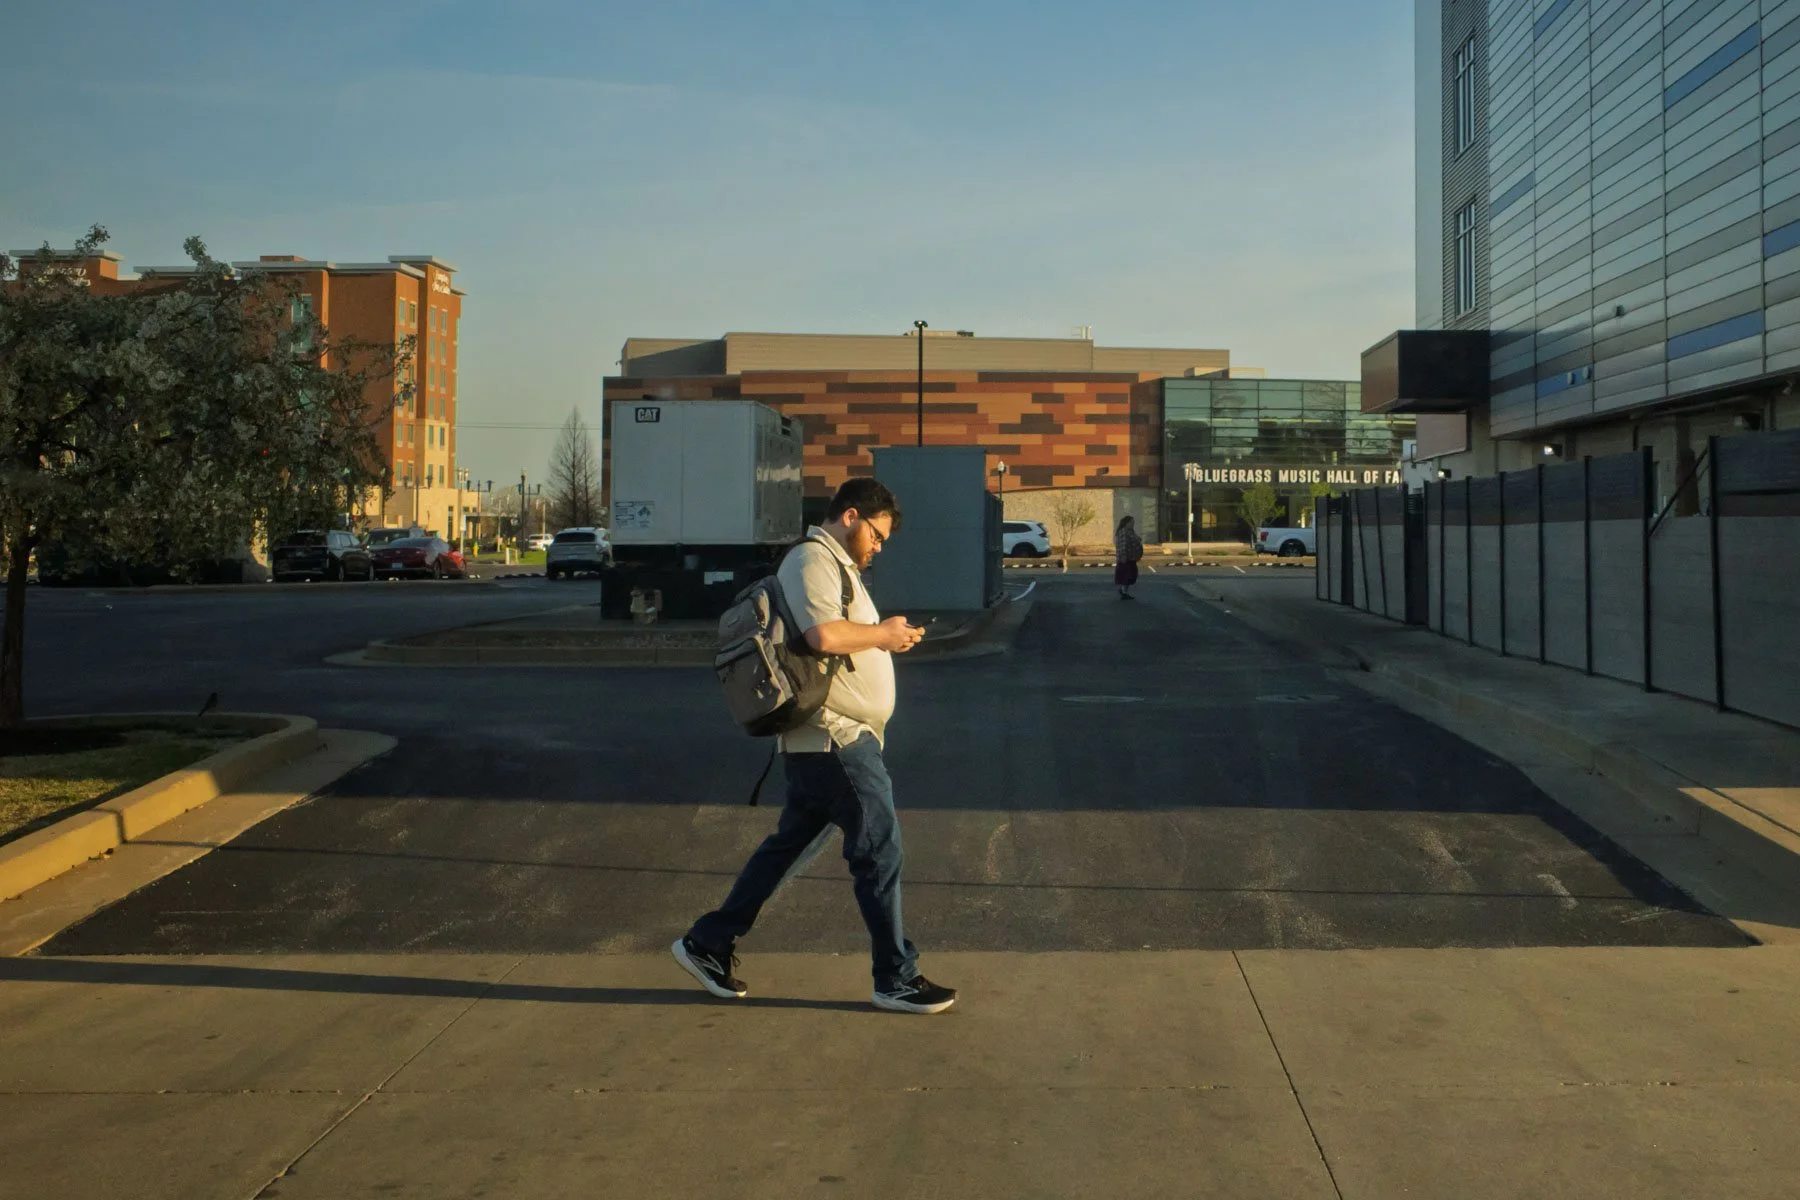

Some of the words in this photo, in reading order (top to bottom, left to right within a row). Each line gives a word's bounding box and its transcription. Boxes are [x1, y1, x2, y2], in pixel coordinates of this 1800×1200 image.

[637, 408, 659, 421] CAT
[1195, 469, 1272, 483] BLUEGRASS
[1278, 469, 1320, 483] MUSIC
[1326, 470, 1357, 484] HALL
[1363, 470, 1379, 484] OF
[1385, 470, 1403, 484] FA
